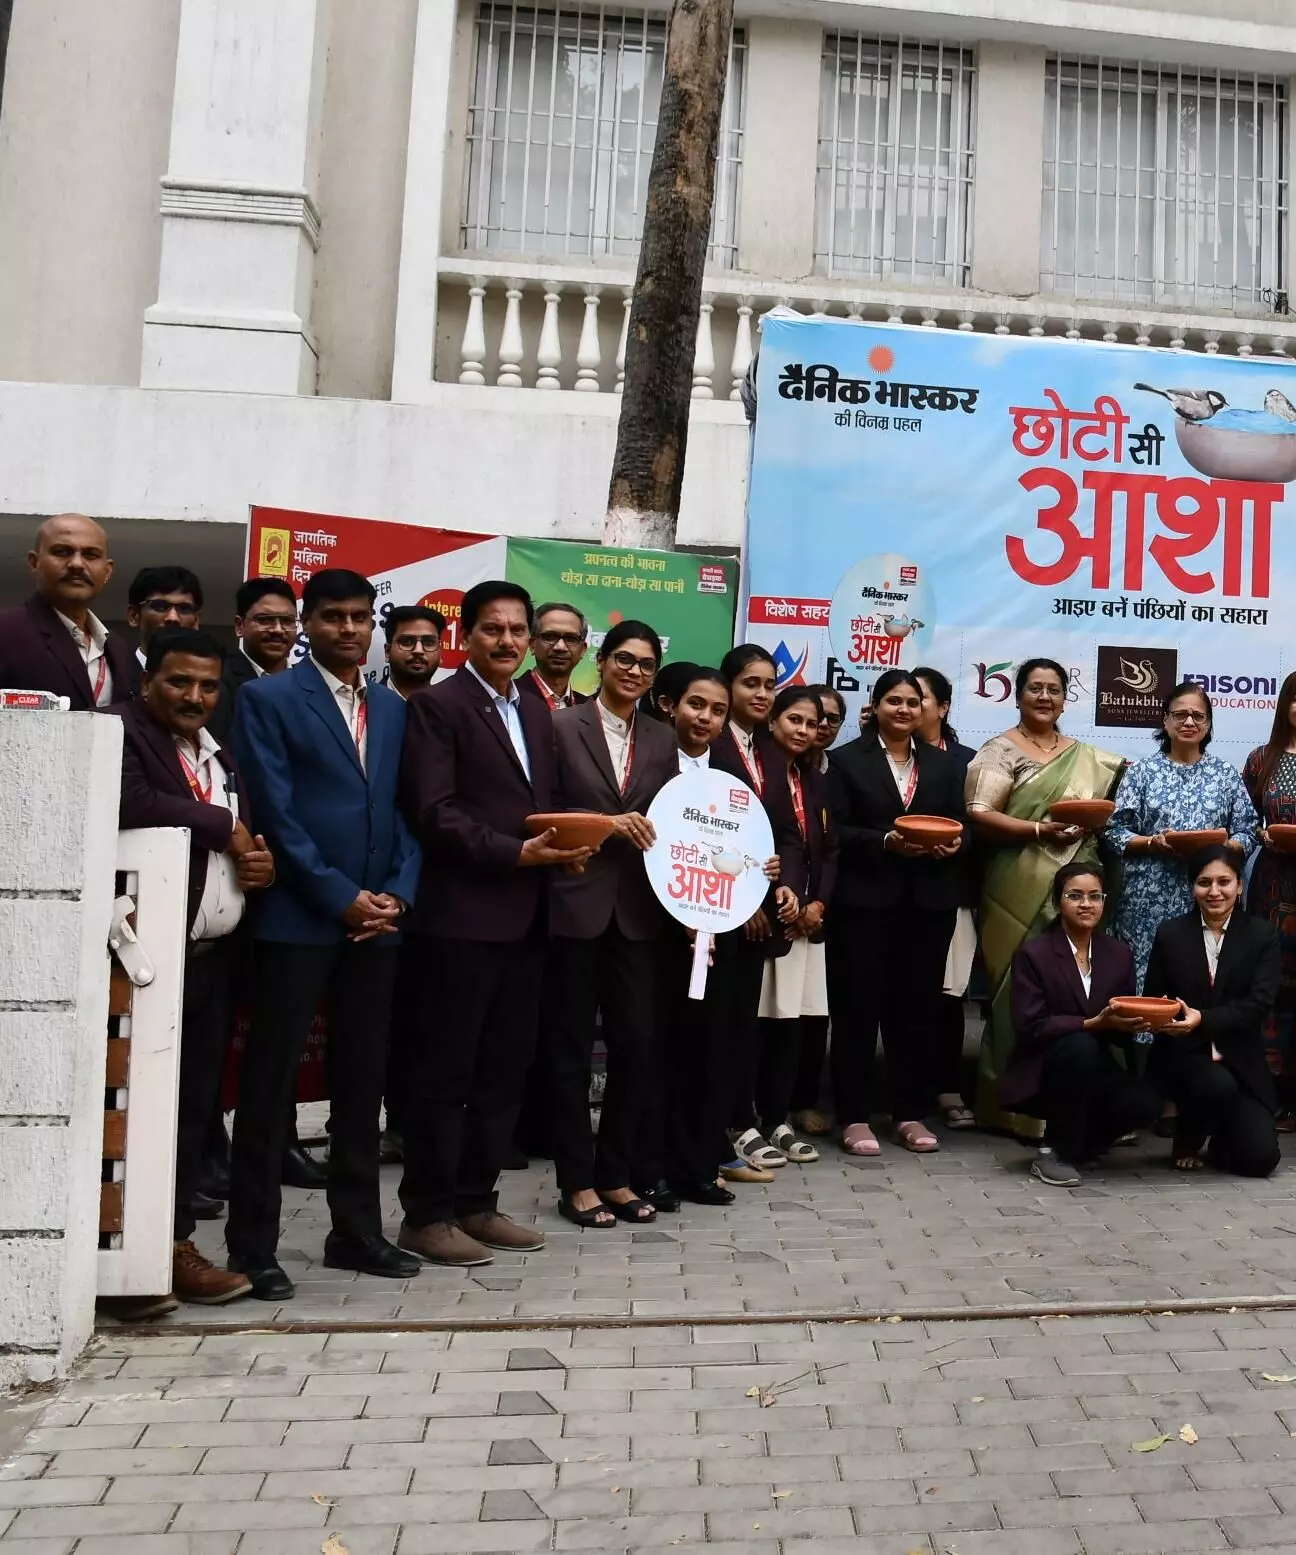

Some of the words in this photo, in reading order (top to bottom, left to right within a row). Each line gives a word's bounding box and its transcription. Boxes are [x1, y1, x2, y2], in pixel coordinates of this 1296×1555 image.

[778, 363, 871, 404] दैनिक
[875, 380, 979, 414] भास्कर
[834, 408, 851, 428] की
[855, 410, 889, 431] विनम्र
[893, 417, 922, 432] पहल
[1009, 388, 1130, 464] छोटी
[1127, 423, 1165, 466] सी
[293, 529, 337, 548] जागतिक
[1005, 466, 1285, 599] आशा
[292, 548, 328, 566] महिला
[583, 553, 618, 568] अपनत्व
[620, 553, 634, 569] की
[637, 558, 666, 572] भावना
[292, 566, 312, 584] दिन
[561, 568, 583, 587] थोड़ा
[585, 573, 599, 586] सा
[649, 580, 662, 592] सा
[664, 578, 685, 594] पानी
[765, 600, 798, 618] विशेष
[1051, 598, 1096, 620] आइए
[1101, 596, 1128, 618] बनें
[1133, 598, 1187, 622] पंछियों
[1191, 606, 1216, 623] का
[1220, 607, 1268, 625] सहारा
[851, 615, 874, 633] छोटी
[848, 633, 904, 666] आशा
[18, 696, 39, 704] CLEAR
[1211, 697, 1276, 709] DUCATION
[710, 816, 740, 832] भास्कर
[670, 840, 699, 864] छोटी
[698, 854, 707, 867] सी
[667, 863, 736, 910] आशा
